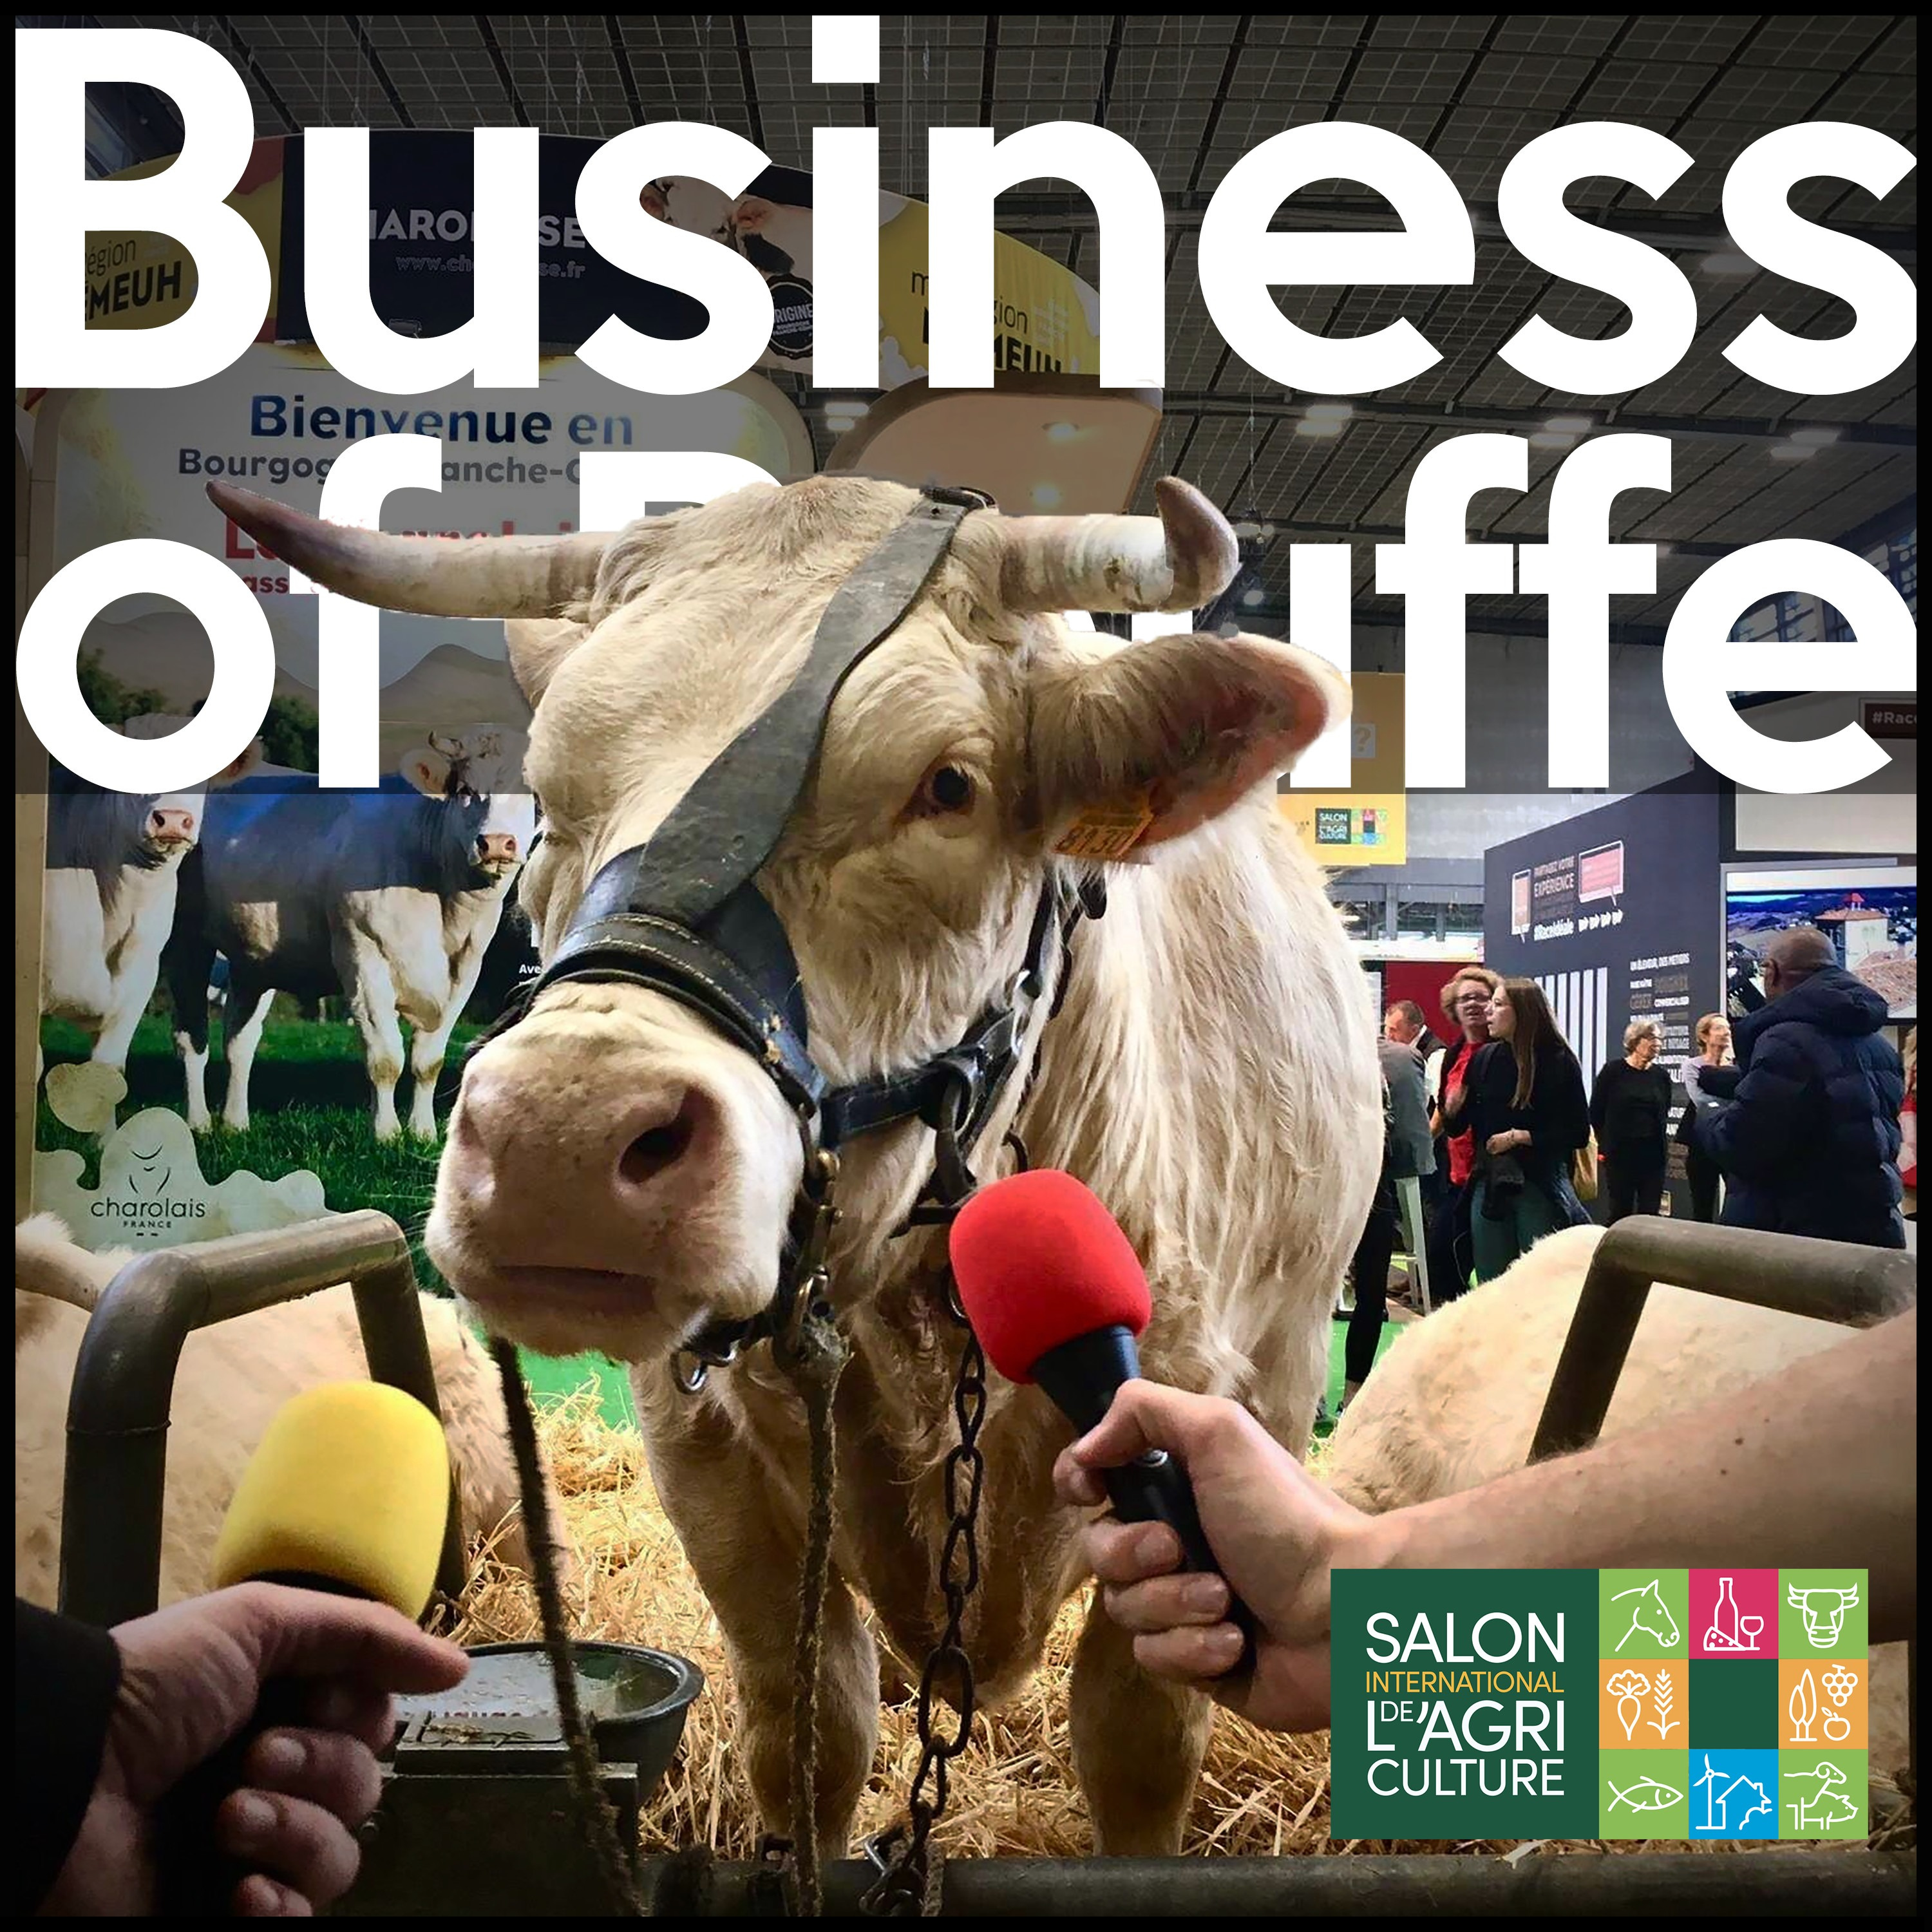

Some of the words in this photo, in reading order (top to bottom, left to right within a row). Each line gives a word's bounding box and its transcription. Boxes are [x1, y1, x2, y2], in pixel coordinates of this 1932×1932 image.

[85, 240, 136, 277] égion
[773, 303, 813, 323] RIGINE
[251, 395, 552, 444] Bienvenue
[568, 413, 632, 445] en
[1319, 813, 1347, 822] SALON
[91, 1197, 205, 1218] charolais
